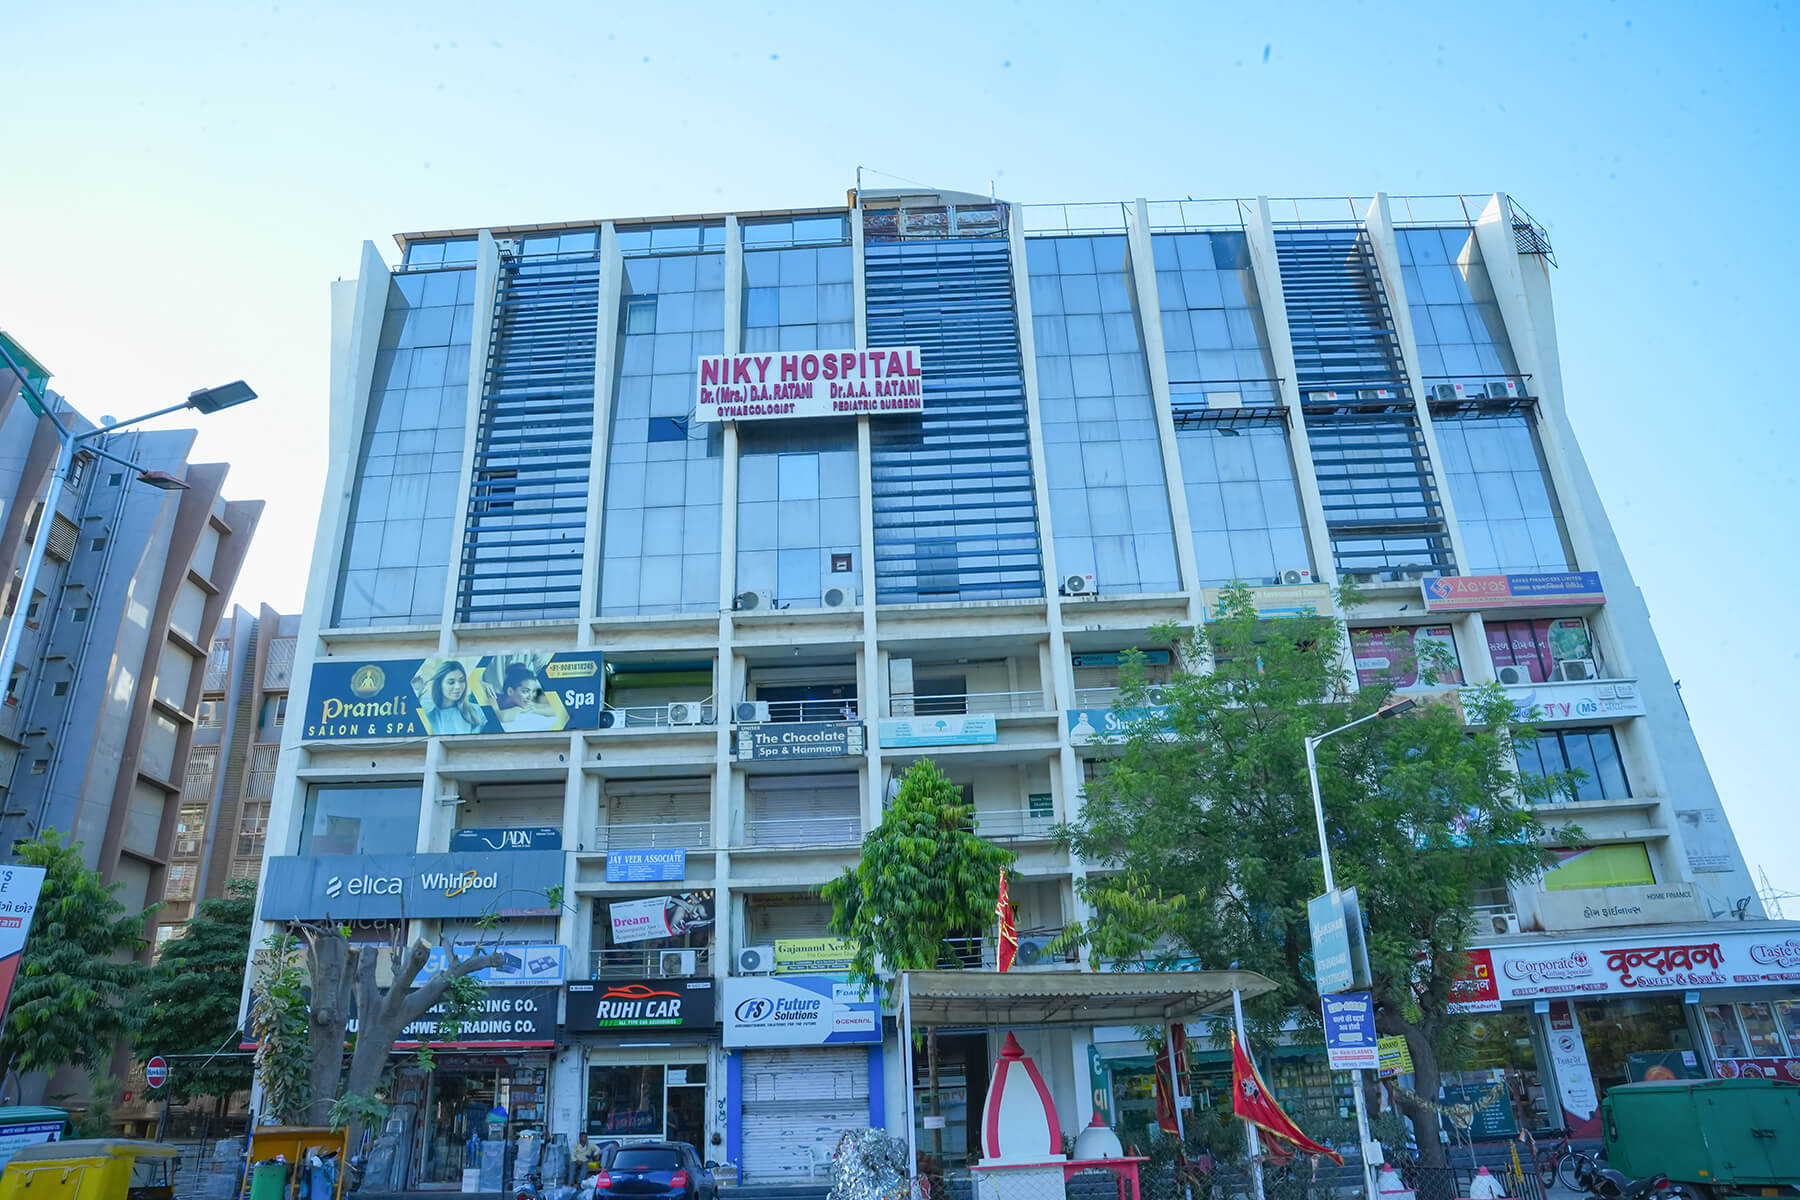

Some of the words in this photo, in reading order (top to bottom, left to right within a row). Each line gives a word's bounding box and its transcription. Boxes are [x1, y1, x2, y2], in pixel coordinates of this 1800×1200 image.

[701, 356, 771, 385] NIKY
[781, 351, 921, 381] HOSPITAL
[875, 379, 921, 397] RATANI
[717, 403, 796, 417] GYNAECOLOGIST
[833, 399, 878, 411] PEDIATRIC
[880, 398, 921, 410] SURGEON
[565, 690, 595, 709] Spa
[321, 696, 407, 724] Pranali
[308, 724, 359, 736] SALON
[368, 723, 376, 735] &
[386, 723, 415, 734] SPA
[755, 733, 779, 744] The
[782, 731, 845, 743] Chocolate
[760, 747, 778, 757] Spa
[782, 746, 789, 754] &
[792, 745, 841, 754] Hammam
[609, 855, 621, 865] JAY
[644, 854, 682, 863] ASSOCIATE
[347, 875, 402, 895] elica
[421, 871, 497, 896] Whirlpool
[613, 916, 650, 928] Dream
[778, 943, 825, 954] Gajanand
[1760, 944, 1792, 959] Taste
[1515, 955, 1574, 976] Corporate
[514, 999, 538, 1012] CO.
[597, 1000, 641, 1018] RUHI
[646, 999, 681, 1018] CAR
[776, 998, 820, 1011] Future
[774, 1010, 818, 1021] Solutions
[458, 1020, 511, 1034] TRADING
[514, 1020, 536, 1033] CO.
